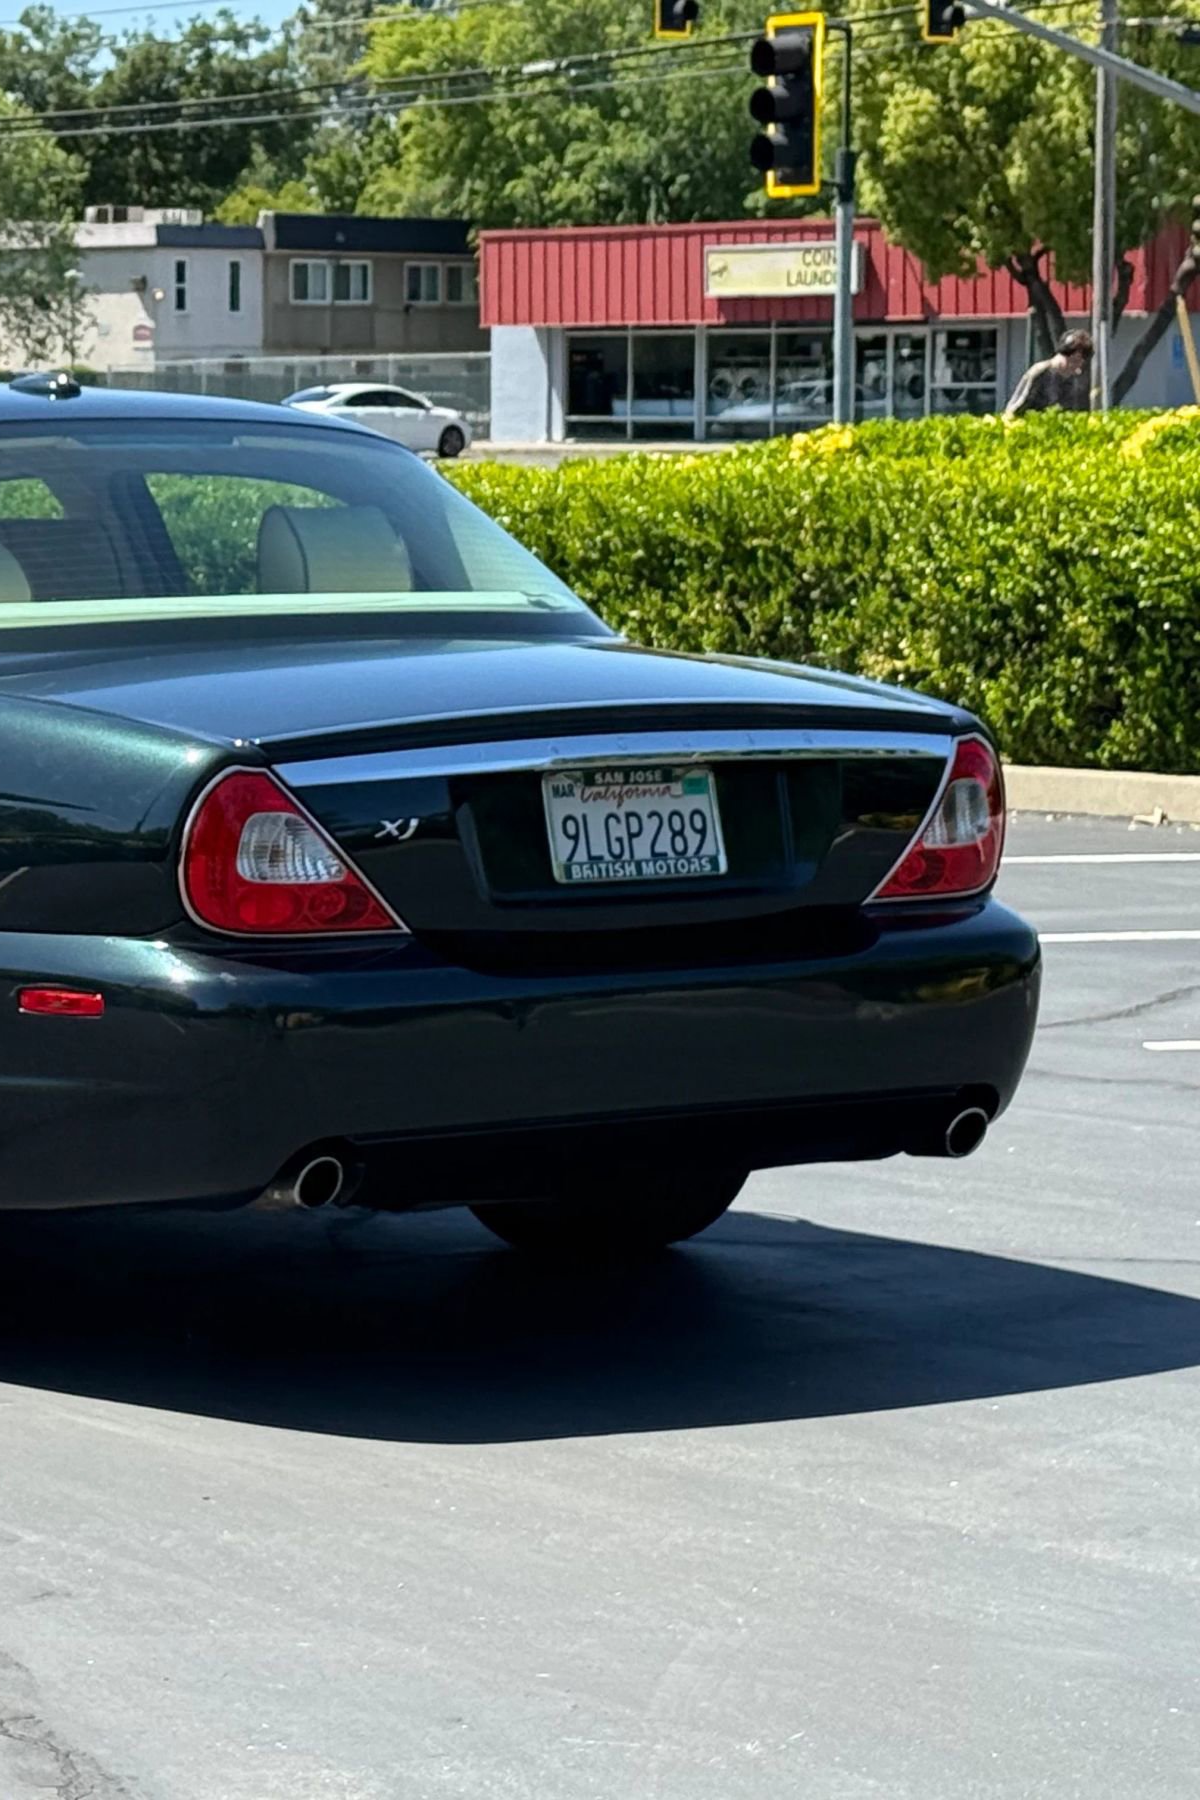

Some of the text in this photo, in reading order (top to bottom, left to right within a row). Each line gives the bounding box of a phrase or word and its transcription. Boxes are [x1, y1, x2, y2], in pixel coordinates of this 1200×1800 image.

[786, 269, 837, 288] LAUND
[594, 769, 663, 785] SAN JOSE
[551, 783, 576, 799] MAR
[579, 784, 683, 809] California
[561, 808, 708, 863] 9LGP289
[570, 856, 712, 880] BRITISH MOTORS
